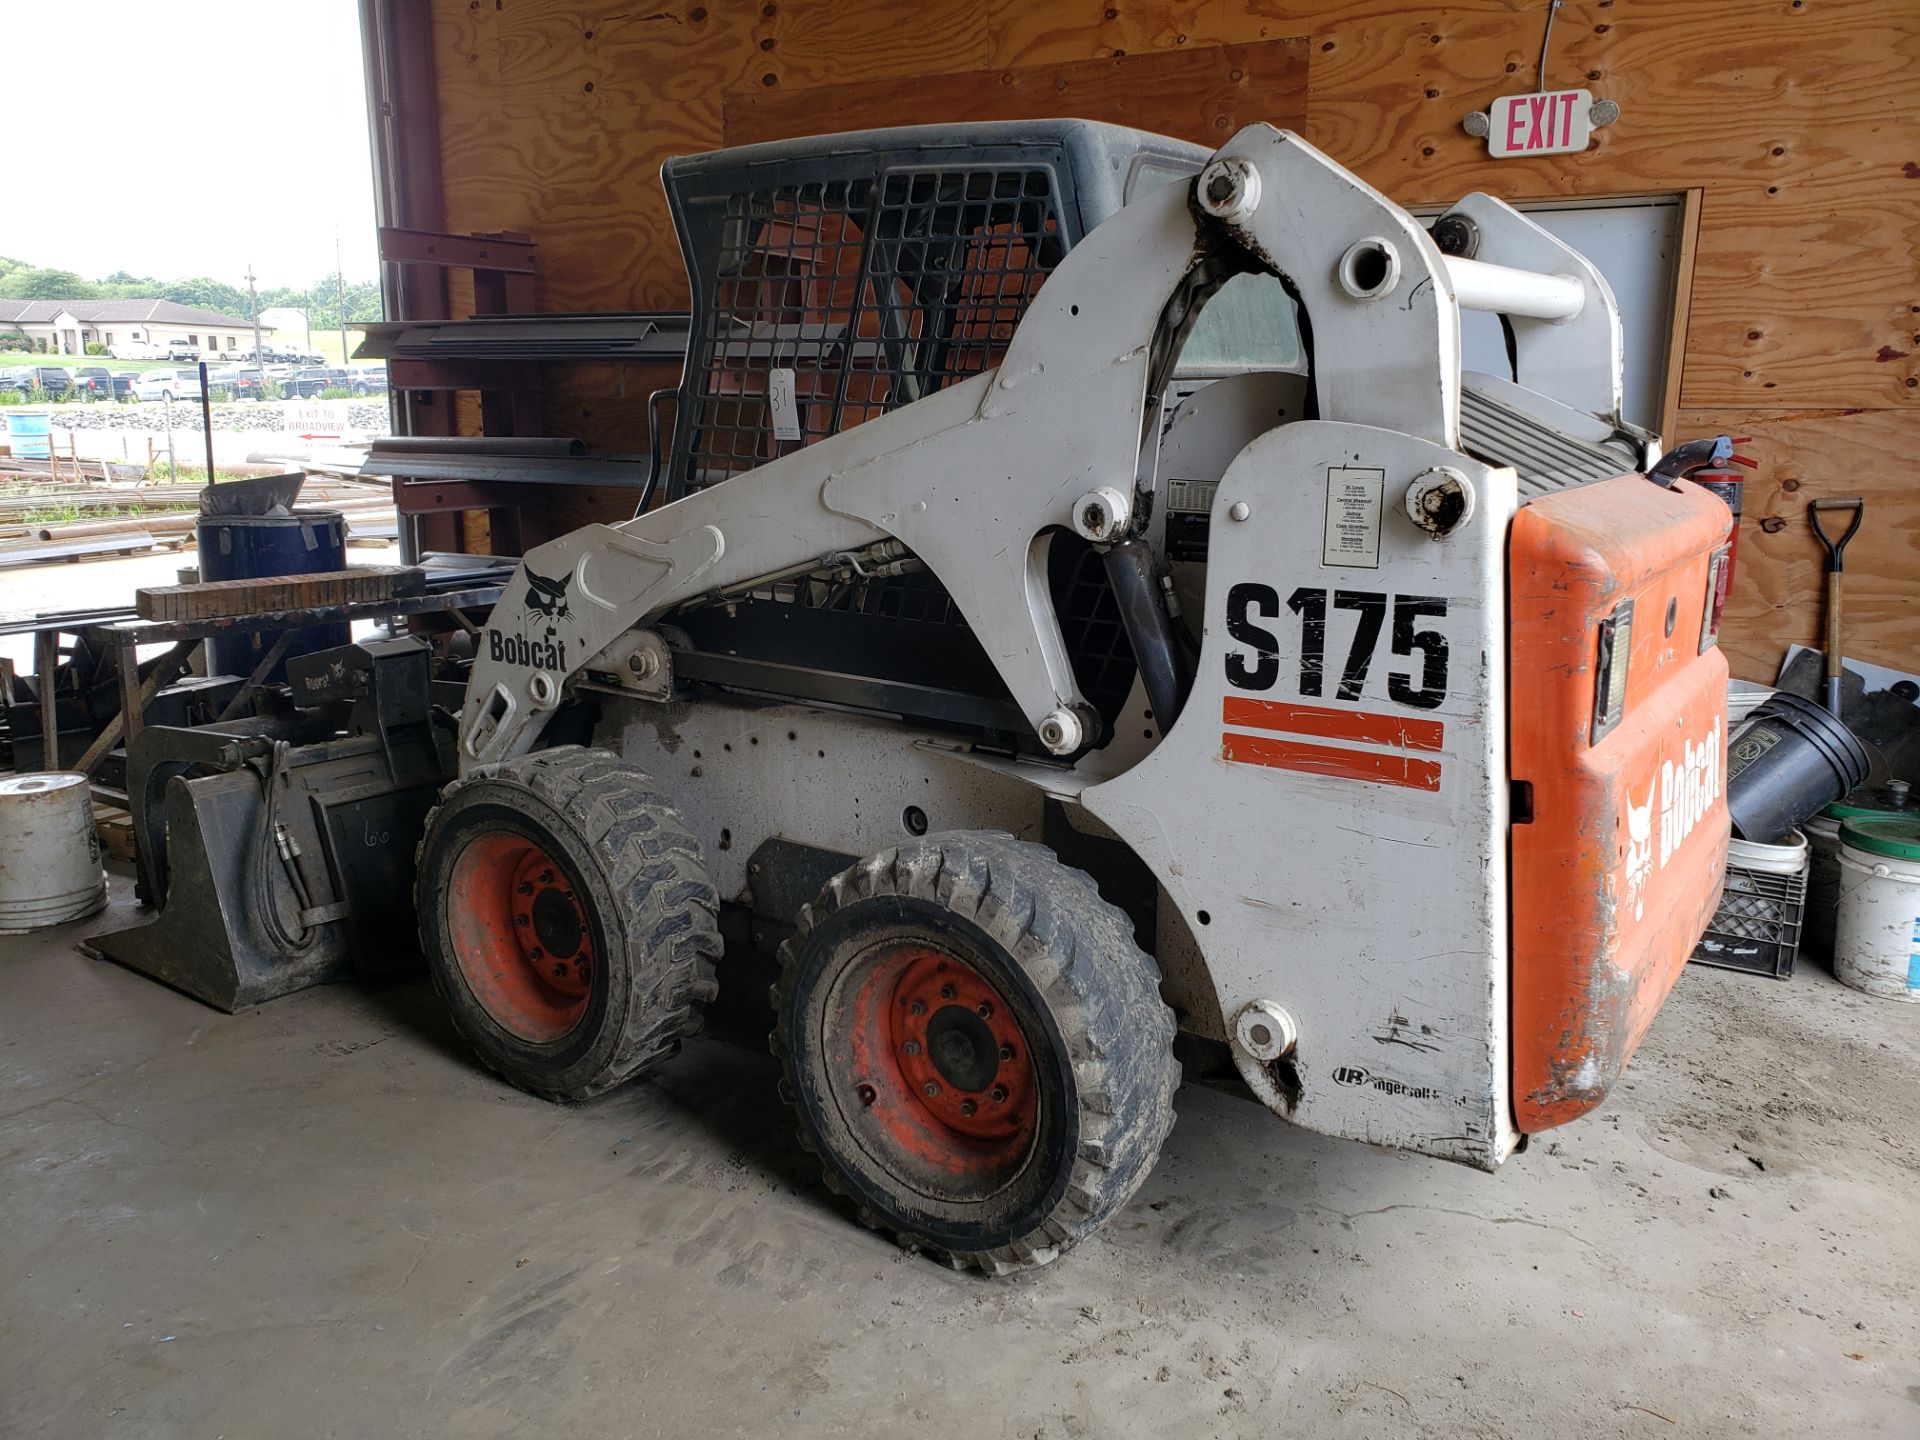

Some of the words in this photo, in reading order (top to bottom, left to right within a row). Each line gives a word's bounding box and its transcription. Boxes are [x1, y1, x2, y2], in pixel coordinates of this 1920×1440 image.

[1506, 93, 1579, 151] EXIT
[772, 386, 787, 412] 31
[288, 421, 345, 431] BROADVIEW
[489, 629, 567, 672] Bobcat
[1224, 582, 1450, 710] S175
[1660, 714, 1721, 870] Bobcat
